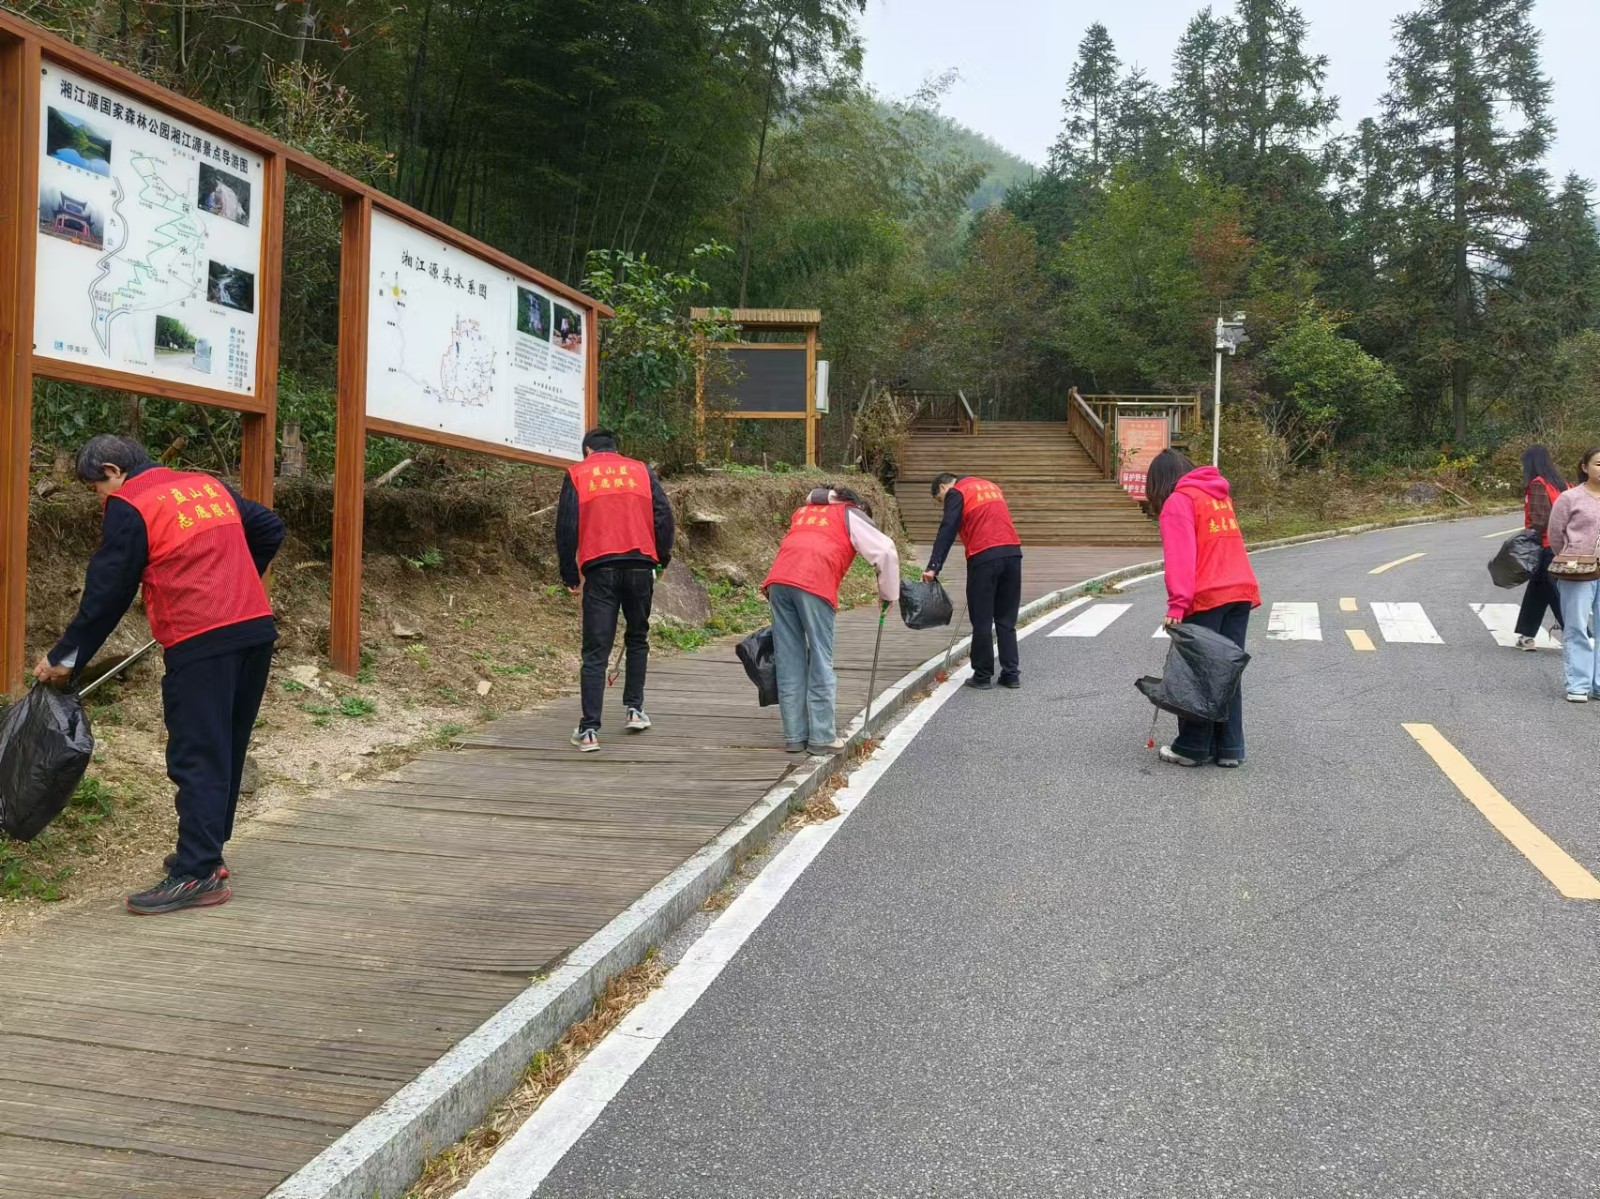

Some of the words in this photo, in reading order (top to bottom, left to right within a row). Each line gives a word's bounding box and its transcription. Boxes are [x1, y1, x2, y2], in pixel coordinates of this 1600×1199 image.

[61, 79, 248, 174] 湘江源国家森林公园湘江源景点导游图
[401, 250, 488, 300] 湘江源头水系图
